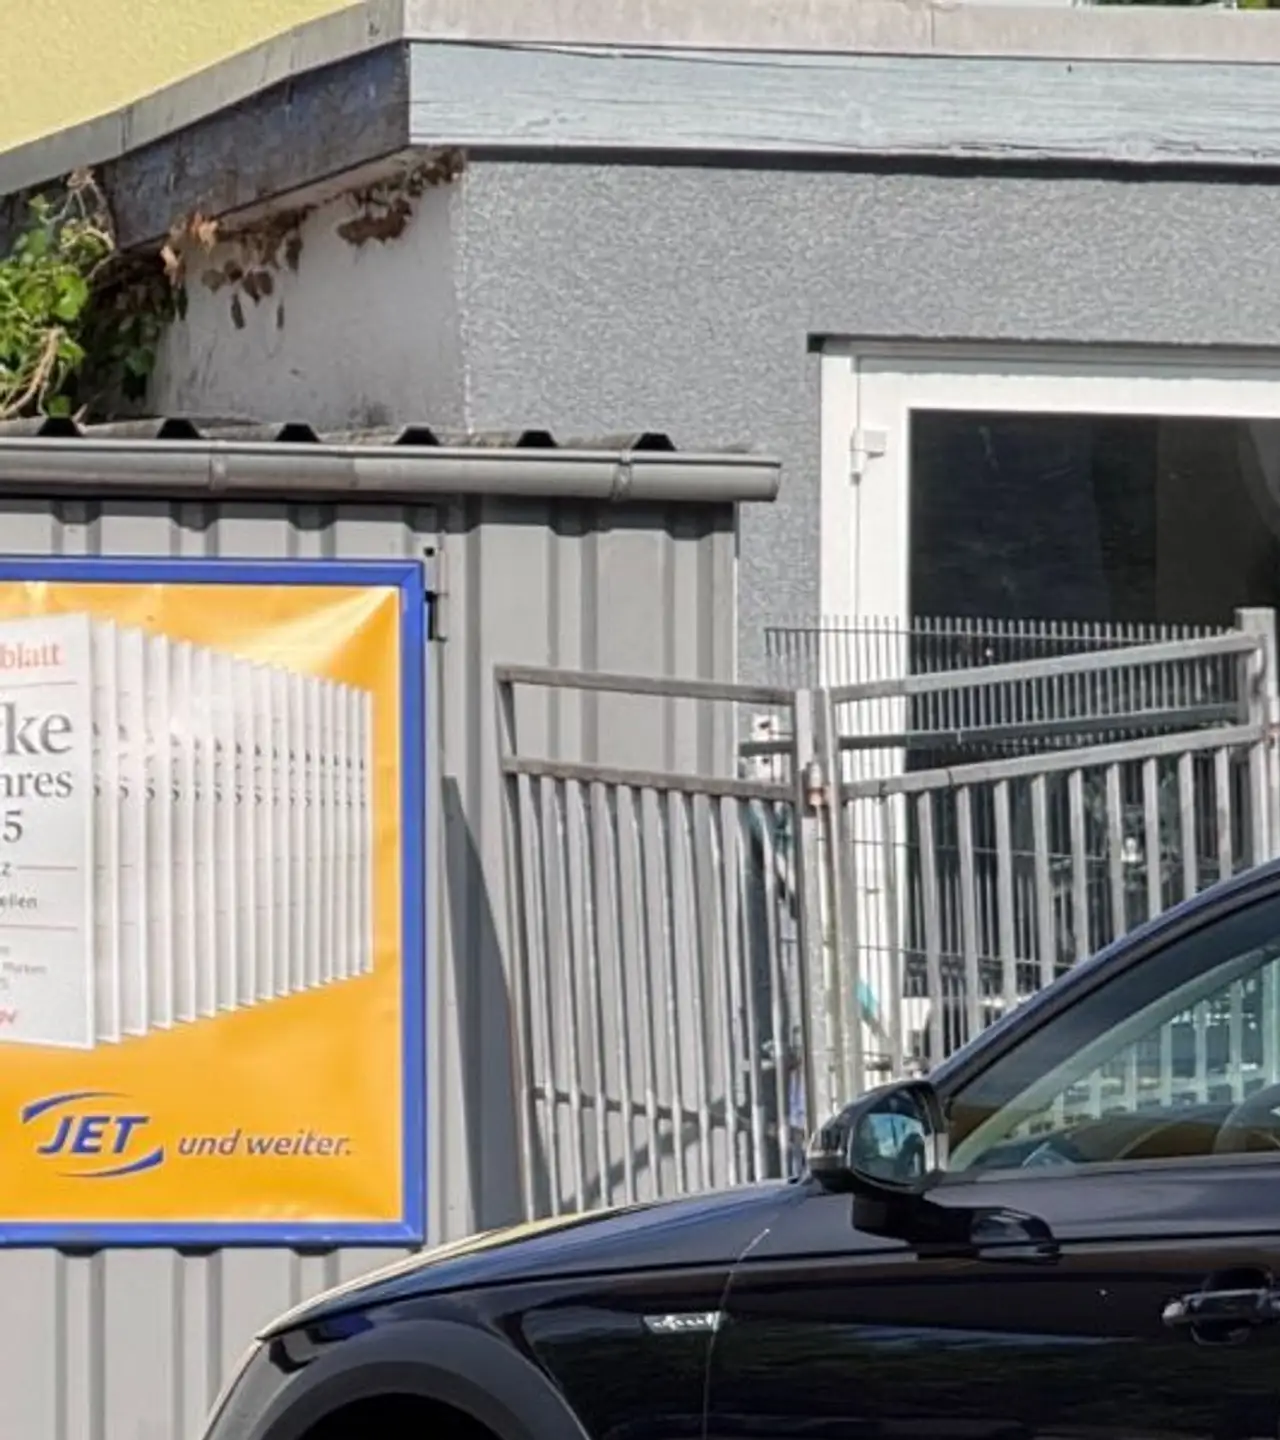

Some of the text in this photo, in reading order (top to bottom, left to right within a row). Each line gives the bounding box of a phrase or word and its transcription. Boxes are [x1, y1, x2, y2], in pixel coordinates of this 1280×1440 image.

[3, 809, 23, 843] 5
[36, 1115, 150, 1155] JET
[176, 1127, 353, 1156] und weiter.
